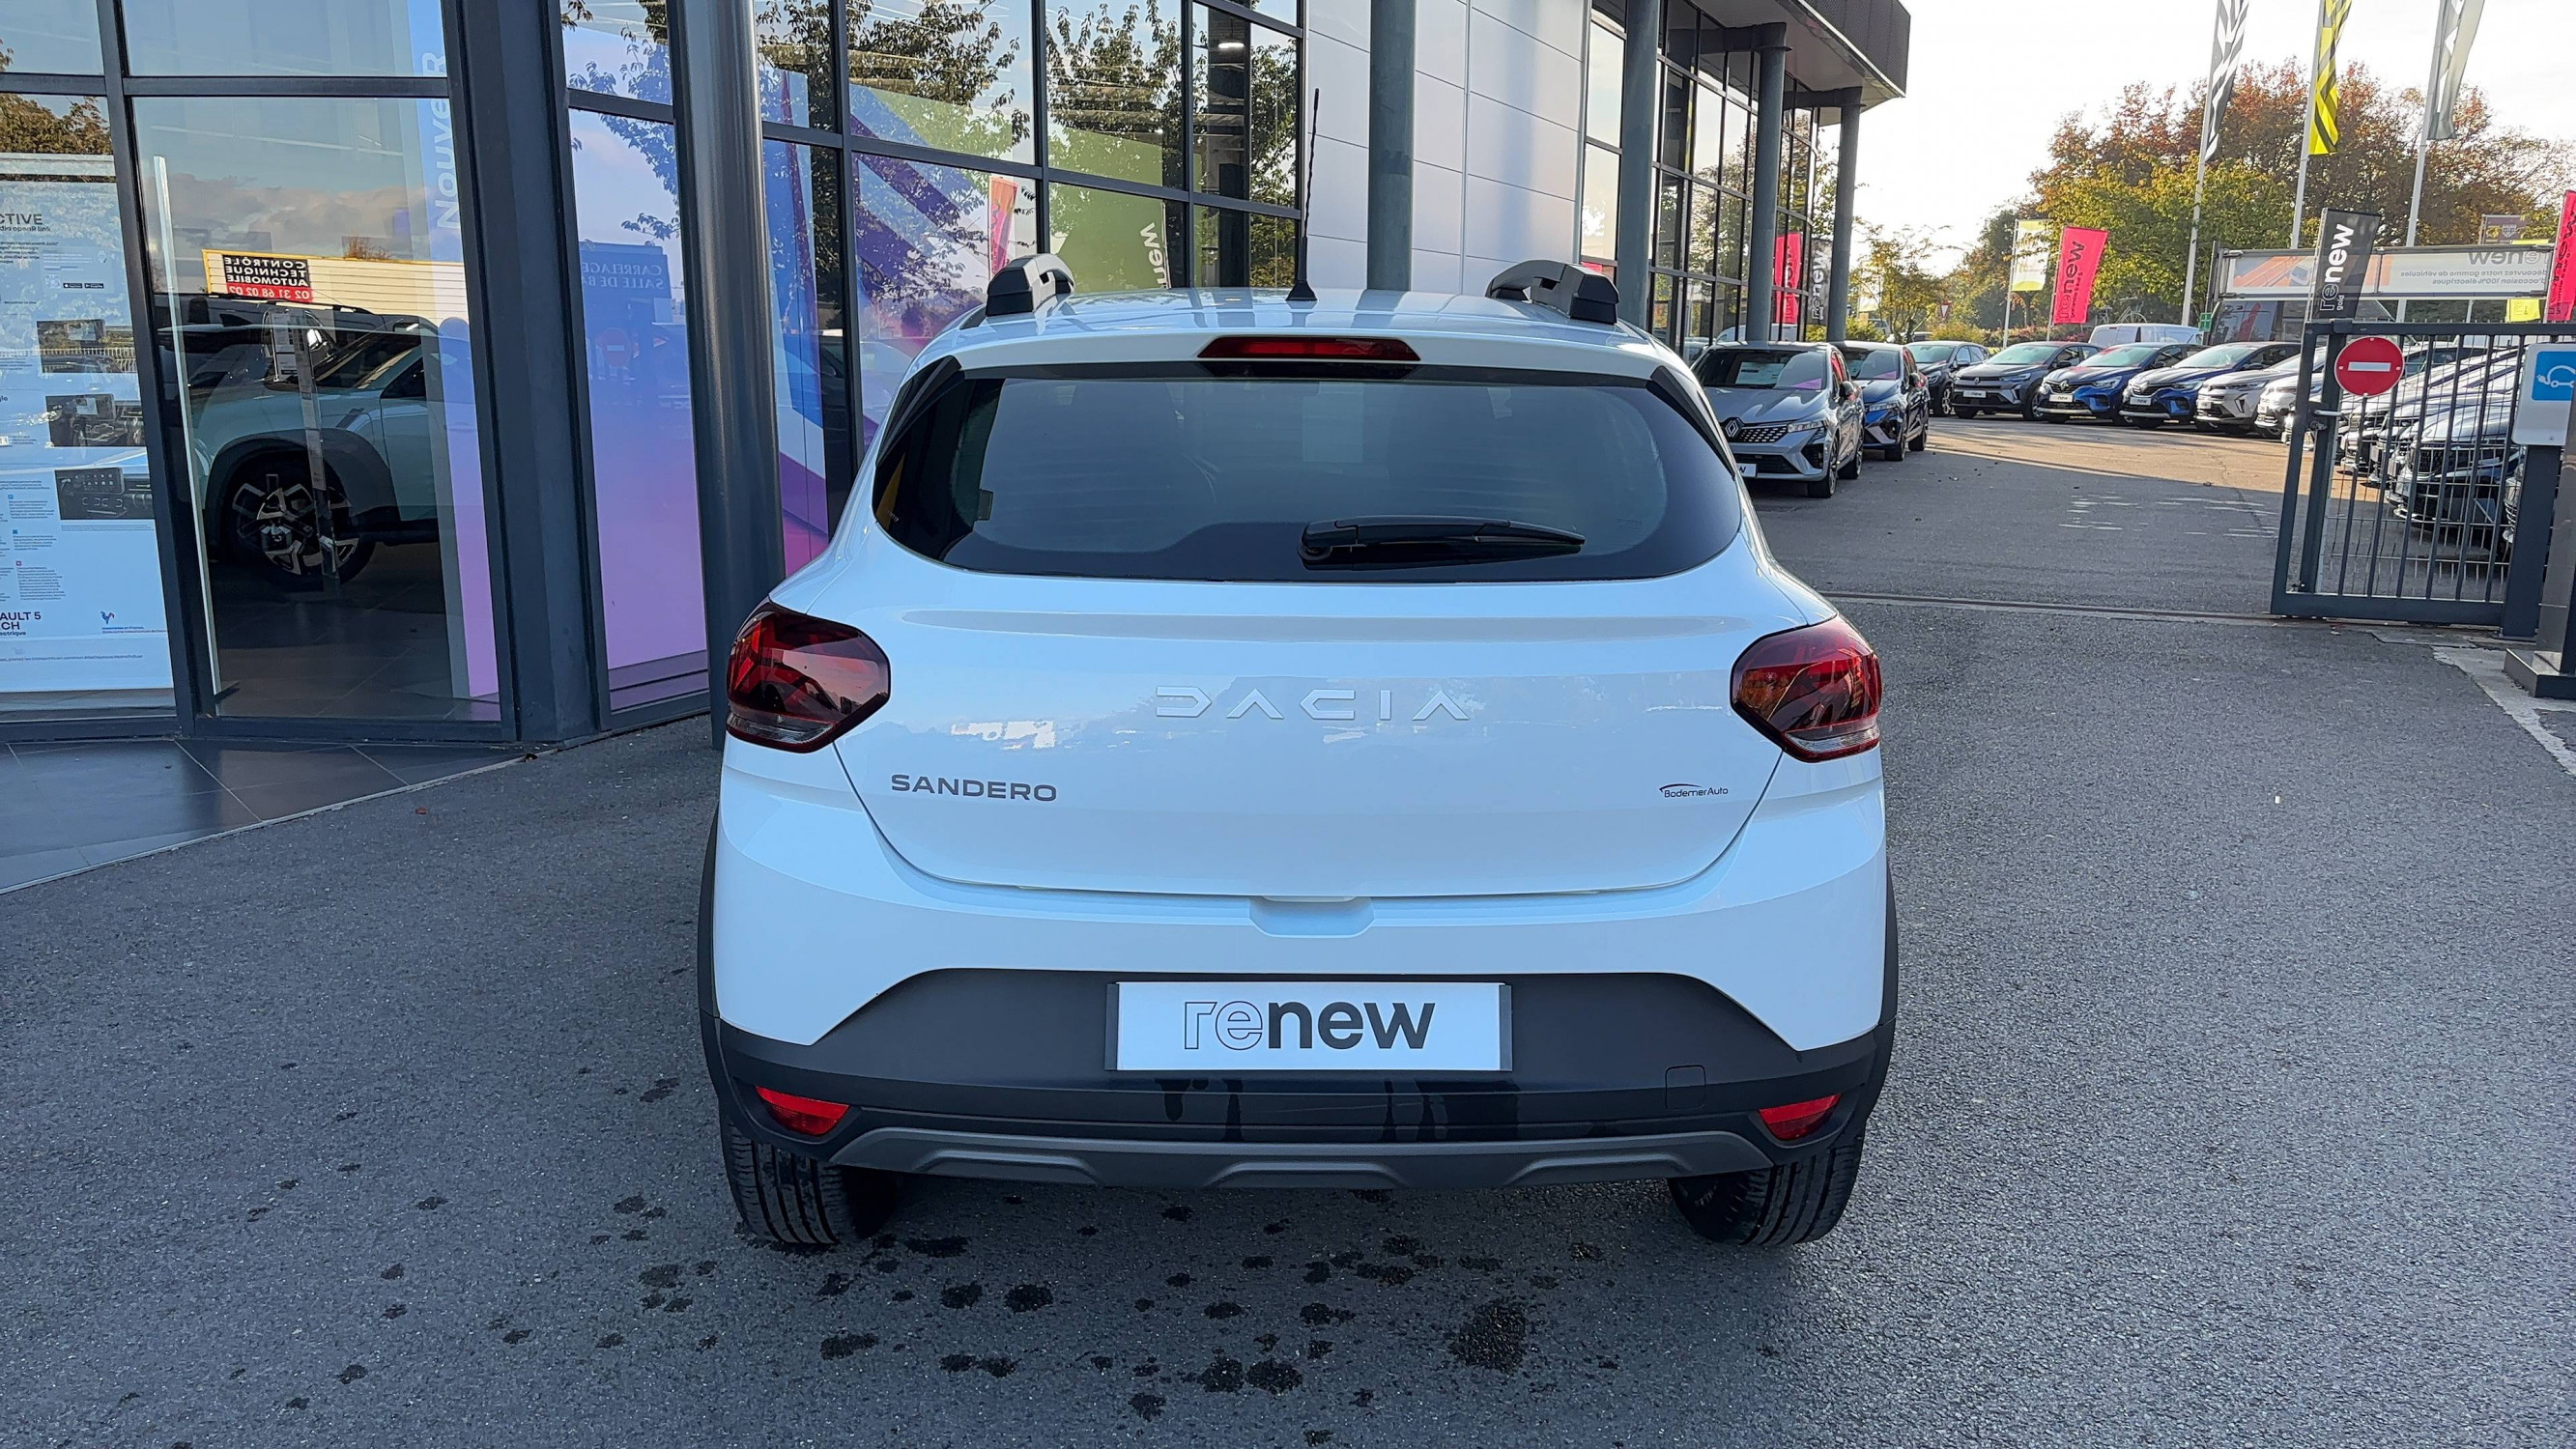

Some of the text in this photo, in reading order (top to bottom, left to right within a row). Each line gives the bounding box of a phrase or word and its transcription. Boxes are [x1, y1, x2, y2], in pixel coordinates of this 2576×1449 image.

[2060, 241, 2085, 319] renew
[2320, 223, 2355, 311] renew
[2336, 295, 2345, 311] gold
[34, 611, 42, 620] 5
[1156, 686, 1471, 721] DACIA
[890, 774, 1057, 803] SANDERO
[1184, 1000, 1436, 1050] renew
